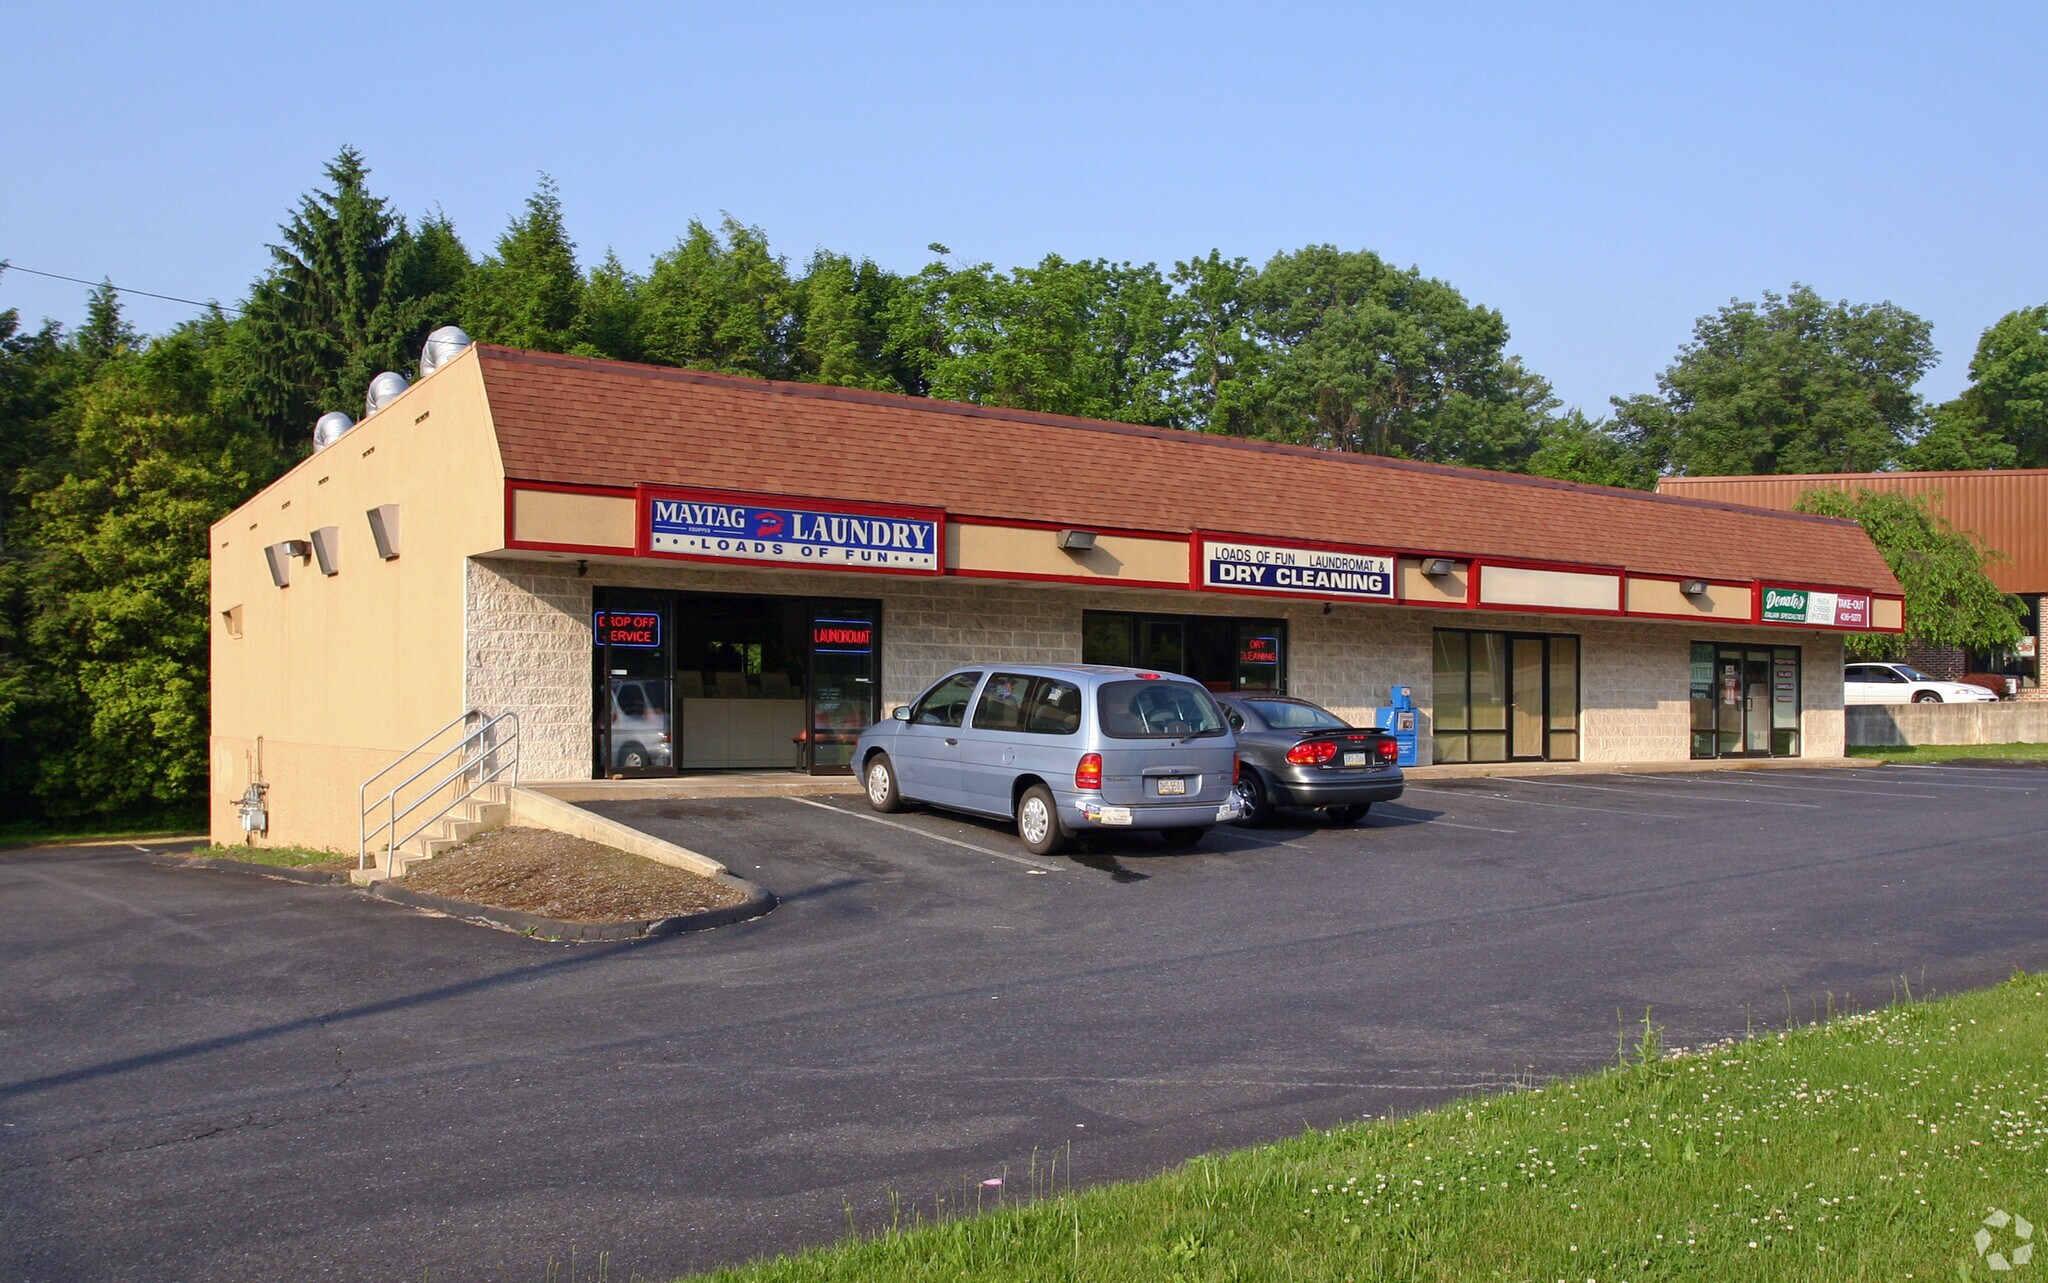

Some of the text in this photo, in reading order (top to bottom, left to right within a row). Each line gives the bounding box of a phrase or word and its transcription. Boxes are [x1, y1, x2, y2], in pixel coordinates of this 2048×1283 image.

[655, 501, 745, 528] MAYTAG
[791, 513, 931, 549] LAUNDRY
[701, 538, 889, 563] LOADS OF FUN
[1215, 547, 1386, 573] LOADS OF FUN LAUNDROMAT &
[1219, 563, 1383, 592] DRY CLEANING
[1837, 597, 1865, 611] TAKE-OUT
[633, 616, 657, 628] OFF
[602, 630, 652, 642] ERVICE
[814, 628, 871, 644] LAUNDROMAT
[1250, 639, 1266, 649] DRY
